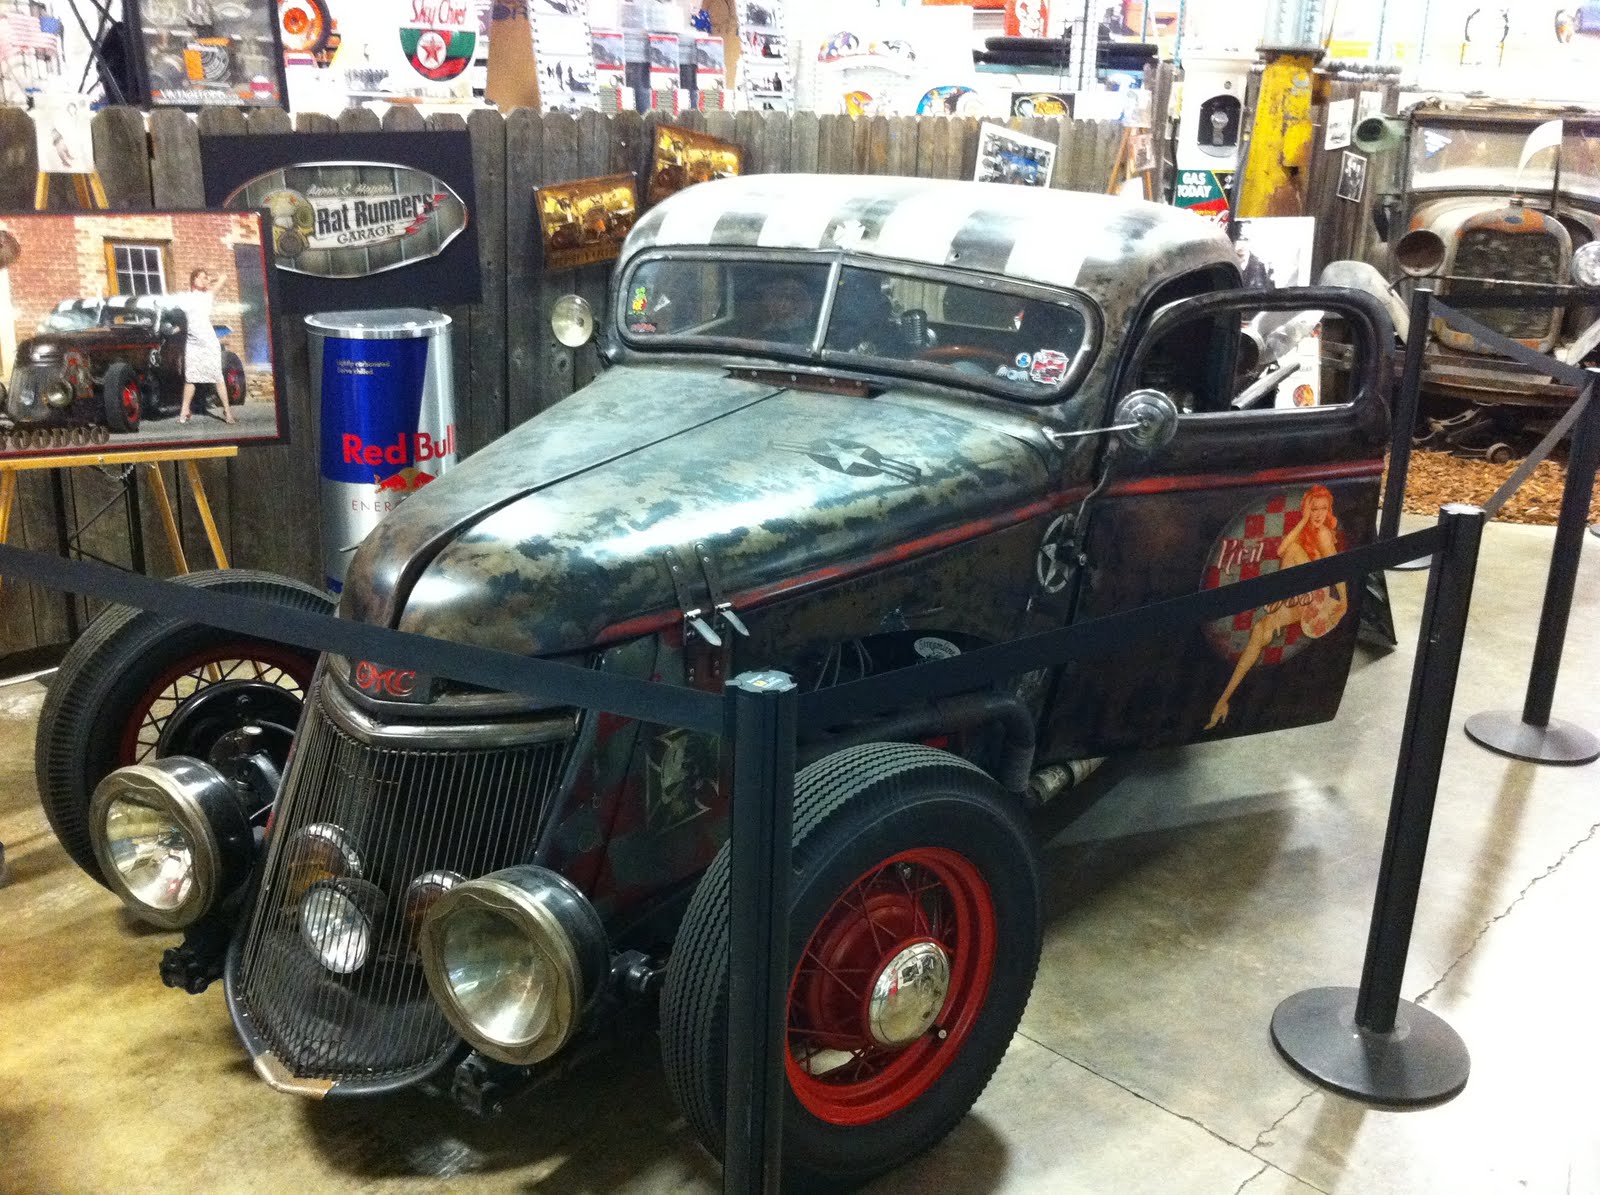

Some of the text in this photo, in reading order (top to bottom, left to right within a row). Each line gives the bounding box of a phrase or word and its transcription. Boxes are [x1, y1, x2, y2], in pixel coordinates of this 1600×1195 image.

[1182, 172, 1206, 185] GAS
[1177, 185, 1212, 198] TODAY
[317, 203, 350, 235] Rat
[336, 224, 396, 244] GARAGE
[342, 424, 456, 466] Red Bull
